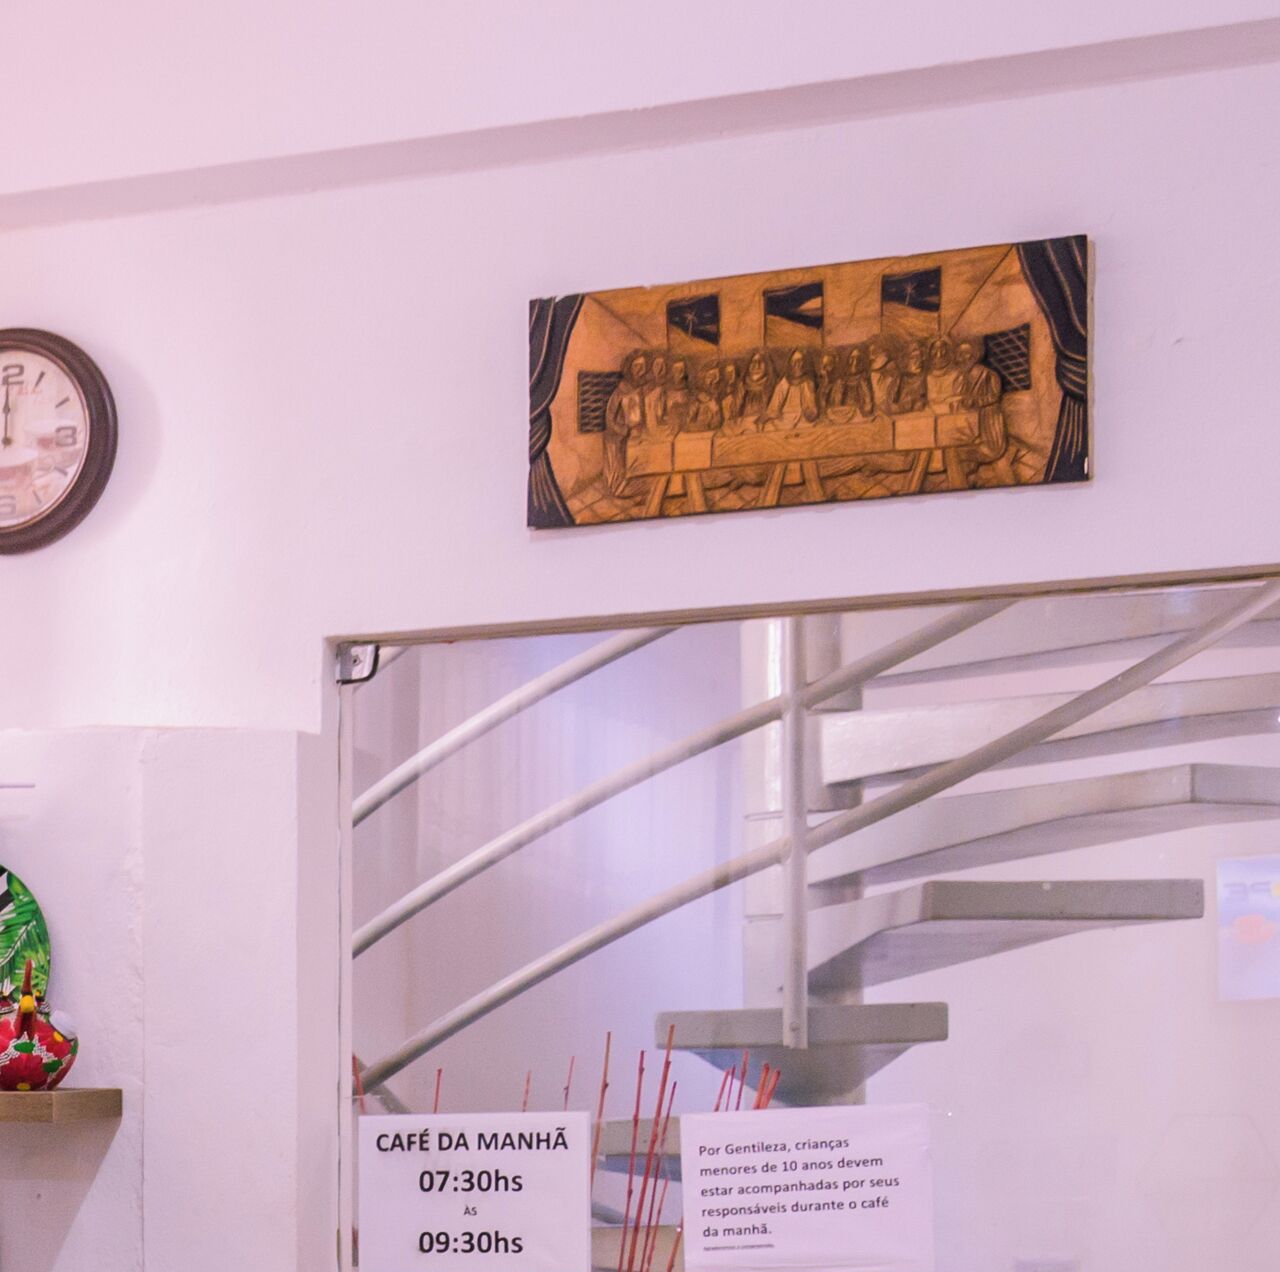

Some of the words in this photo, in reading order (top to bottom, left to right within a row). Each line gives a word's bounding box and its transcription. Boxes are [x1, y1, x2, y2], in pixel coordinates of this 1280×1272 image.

[55, 426, 78, 447] 3
[376, 1128, 430, 1152] CAFÉ
[438, 1132, 470, 1151] DA
[477, 1127, 569, 1151] MANHÃ
[699, 1145, 721, 1157] Por
[725, 1142, 791, 1155] Gentileza,
[795, 1138, 850, 1151] crianças
[700, 1165, 757, 1177] menores
[761, 1162, 777, 1173] de
[782, 1161, 798, 1172] 10
[801, 1160, 833, 1172] anos
[837, 1156, 883, 1169] devem
[419, 1169, 523, 1193] 07:30hs
[701, 1185, 733, 1197] estar
[737, 1178, 839, 1196] acompanhadas
[842, 1178, 866, 1192] por
[869, 1176, 900, 1188] seus
[701, 1203, 787, 1218] responsáveis
[791, 1200, 844, 1213] durante
[848, 1200, 857, 1210] o
[861, 1196, 889, 1209] café
[703, 1226, 719, 1238] da
[722, 1223, 772, 1237] manhã.
[418, 1230, 523, 1254] 09:30hs
